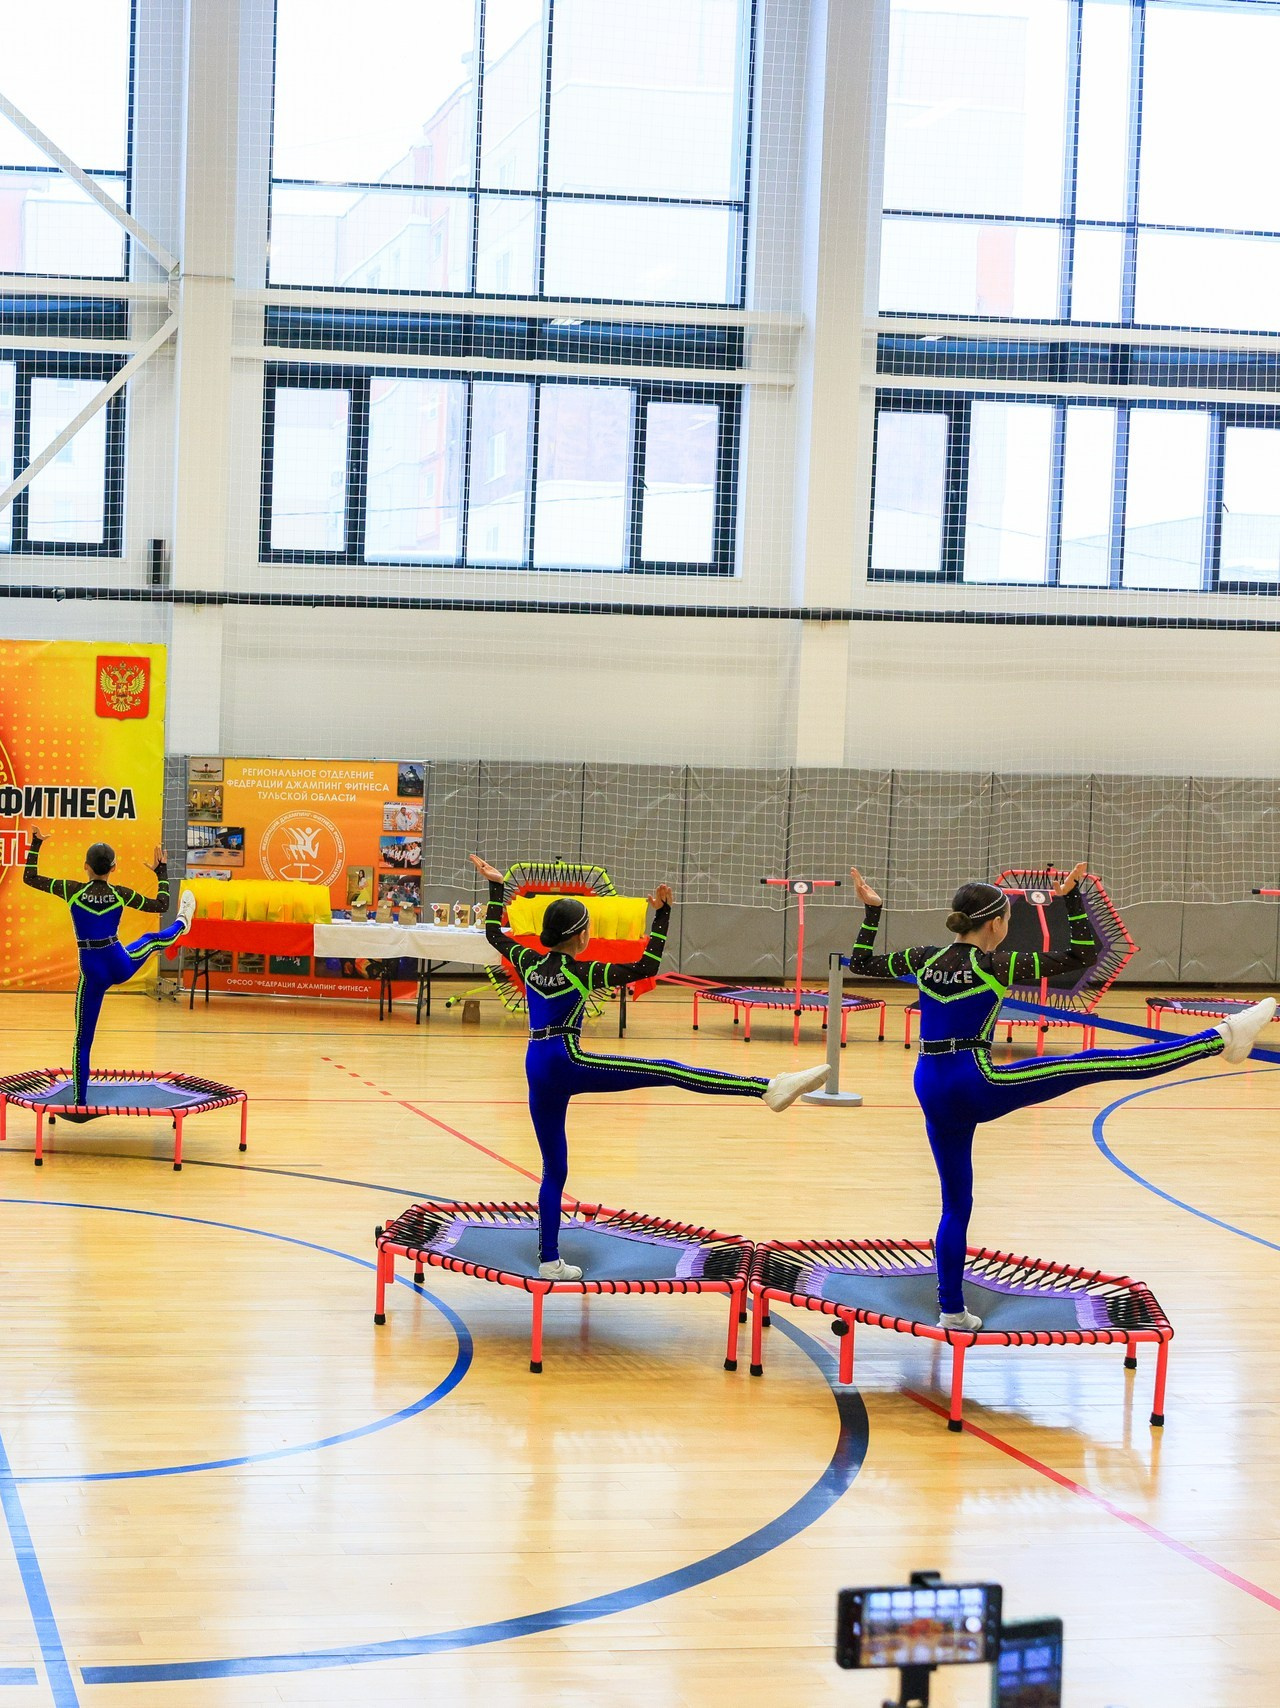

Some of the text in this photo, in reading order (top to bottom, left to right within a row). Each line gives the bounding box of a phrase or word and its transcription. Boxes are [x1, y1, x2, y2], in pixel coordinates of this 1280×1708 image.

[242, 768, 374, 779] РЕГИОНАЛЬНОЕ ОТДЕЛЕНИЕ
[227, 779, 389, 792] ФЕДЕРАЦИИ ДЖАМПИНГ ФИТНЕСА
[257, 790, 356, 802] ТУЛЬСКОЙ ОБЛАСТИ
[81, 893, 116, 904] POLICE
[924, 967, 973, 984] POLICE
[297, 982, 336, 991] ДЖАМПИНГ
